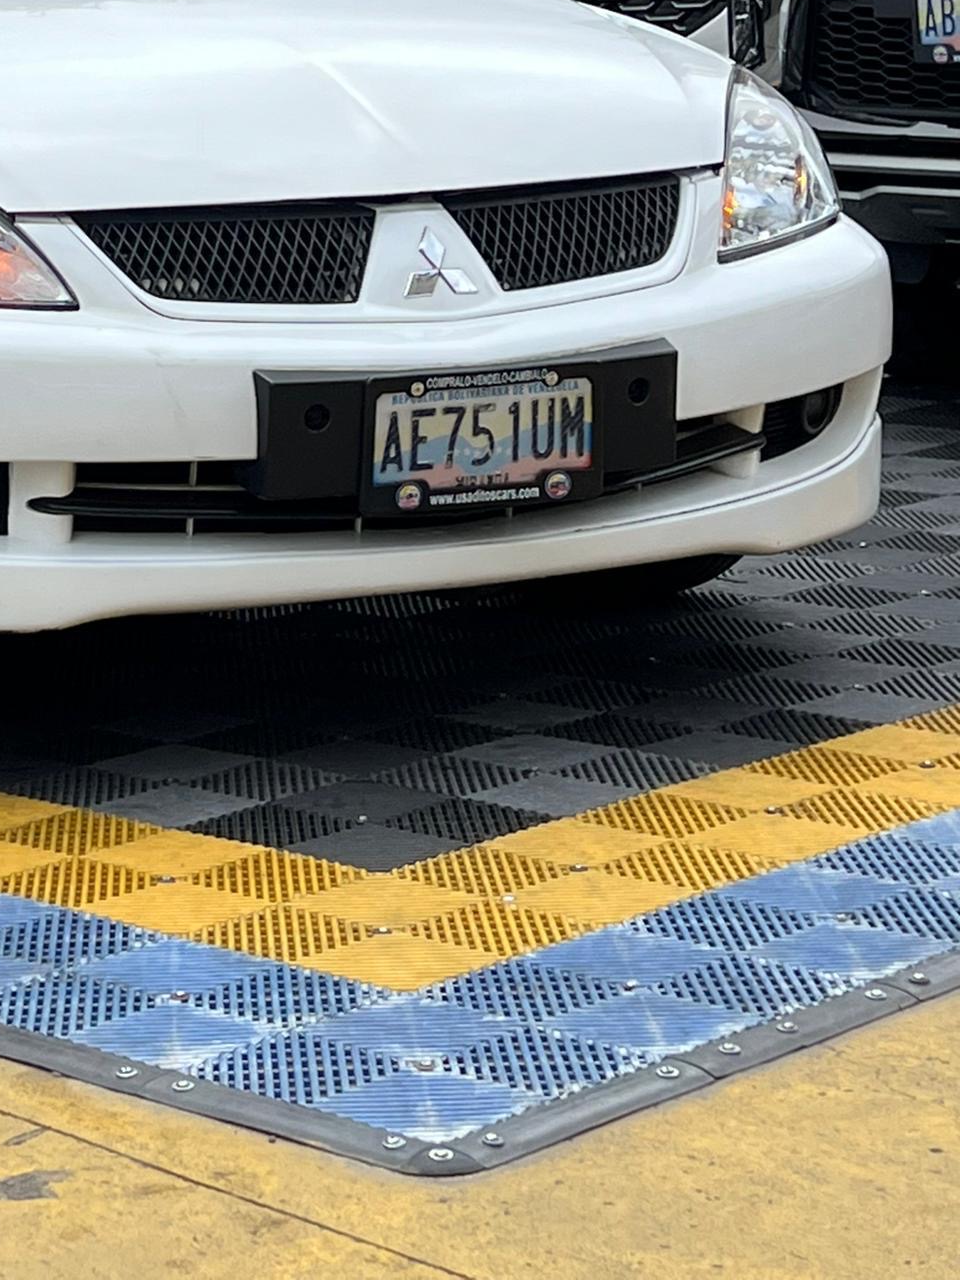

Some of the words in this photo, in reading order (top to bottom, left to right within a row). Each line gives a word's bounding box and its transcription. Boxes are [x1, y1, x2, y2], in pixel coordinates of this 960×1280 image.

[448, 385, 510, 402] BOLIVARIANA
[512, 382, 524, 395] DE
[380, 395, 585, 474] AE751UM
[429, 486, 540, 506] www.usaditoscars.com
